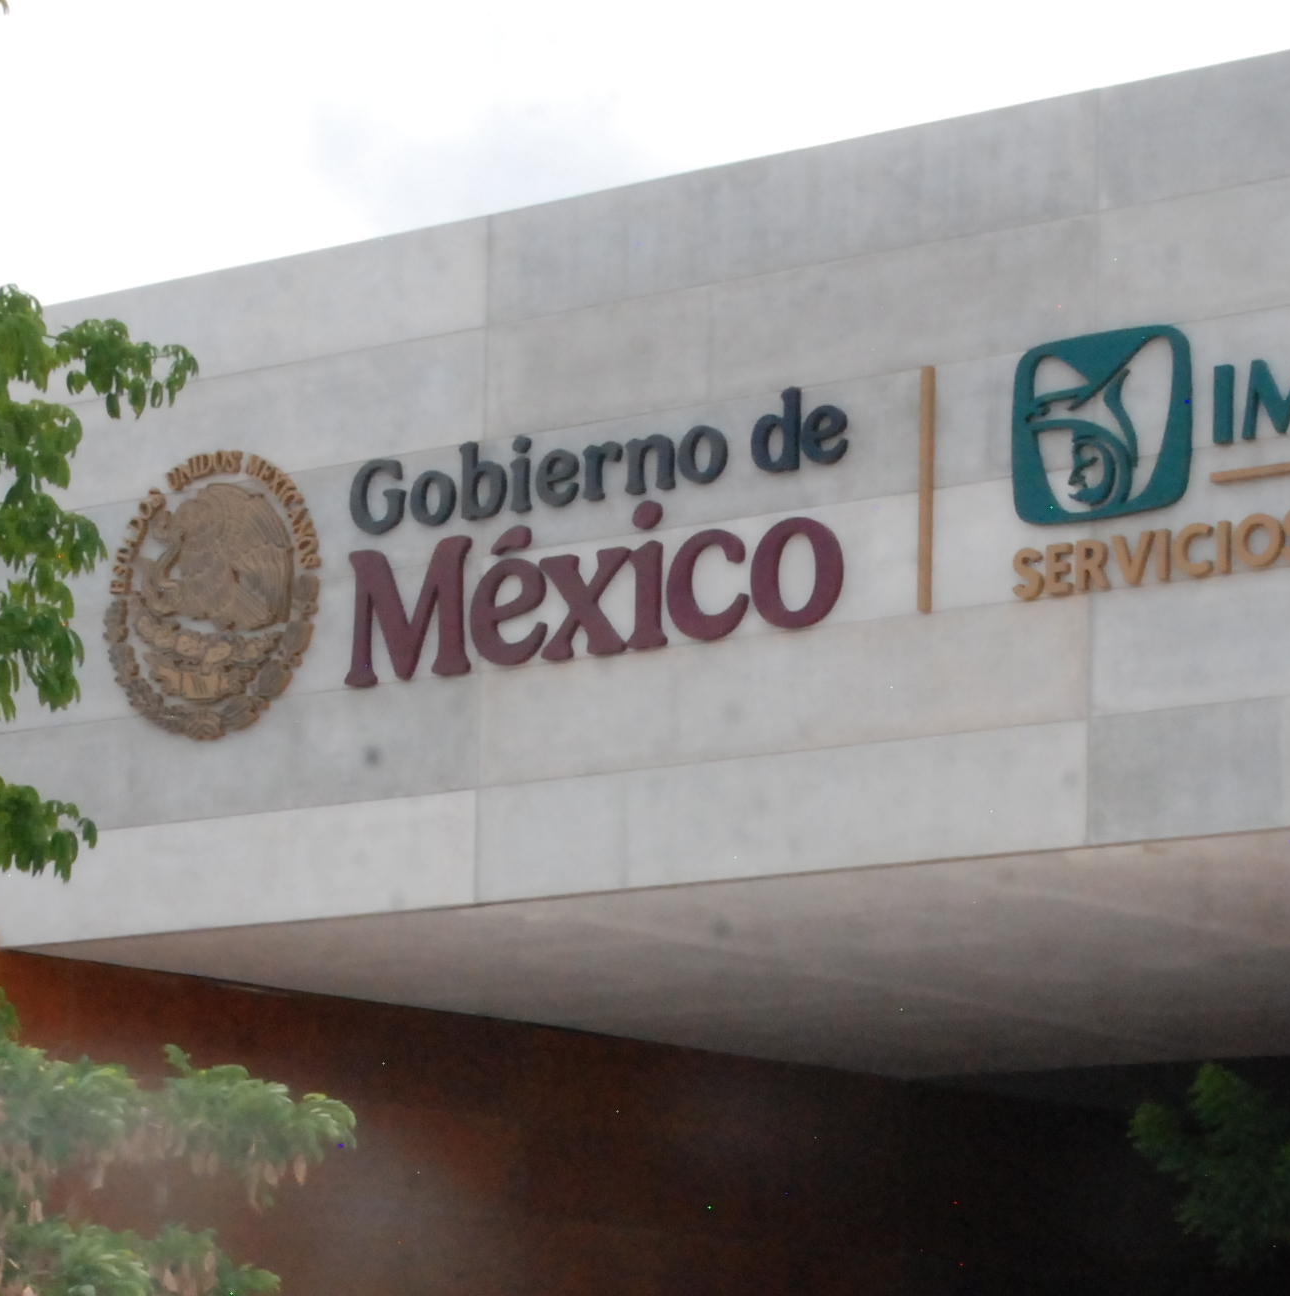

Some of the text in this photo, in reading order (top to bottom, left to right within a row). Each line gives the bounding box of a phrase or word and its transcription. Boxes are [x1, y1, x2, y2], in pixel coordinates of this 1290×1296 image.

[349, 387, 848, 535] Gobierno de
[345, 502, 843, 688] México
